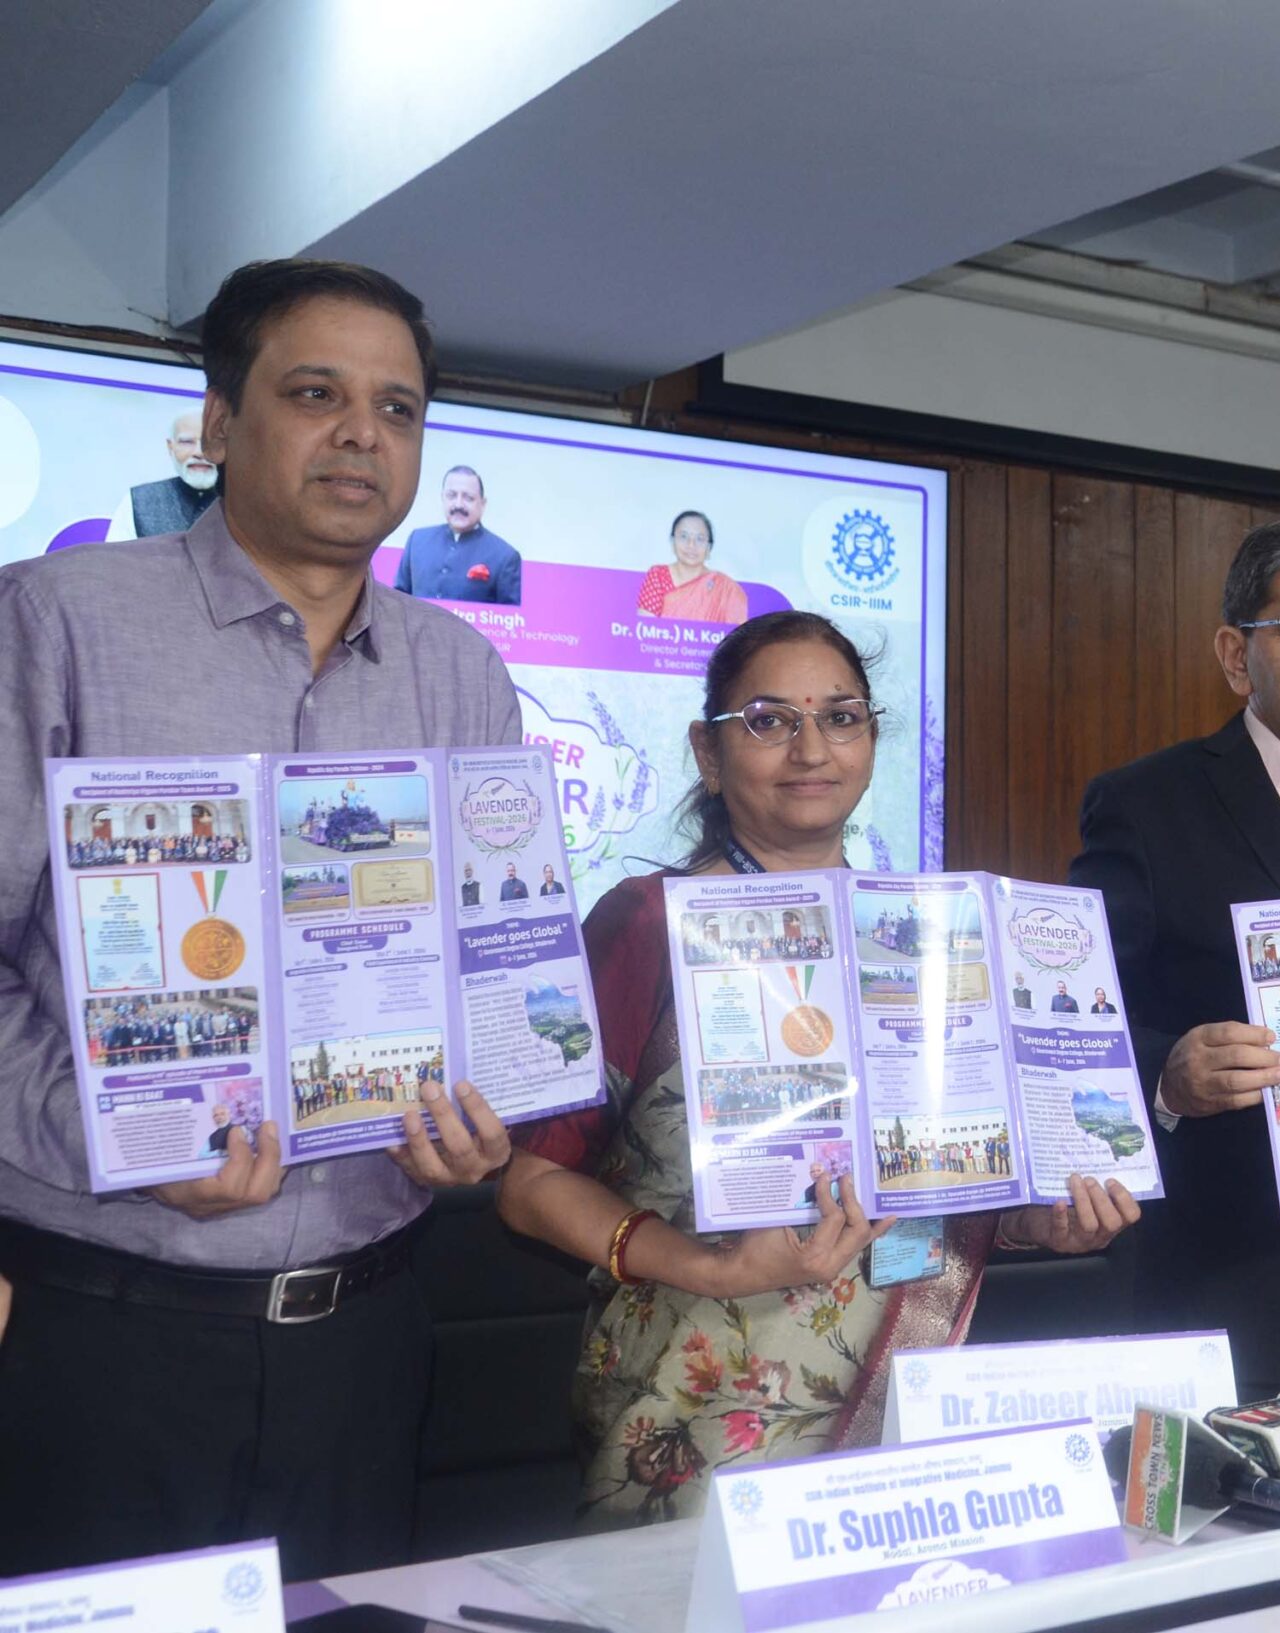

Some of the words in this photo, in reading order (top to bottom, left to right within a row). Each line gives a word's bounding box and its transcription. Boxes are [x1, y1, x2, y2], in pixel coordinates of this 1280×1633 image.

[829, 593, 893, 611] CSIR-IIIM
[479, 610, 525, 630] Singh
[510, 631, 517, 639] &
[520, 630, 580, 646] Technology
[611, 622, 633, 637] Dr.
[635, 622, 680, 643] (Mrs.)
[683, 627, 700, 641] N.
[495, 643, 511, 652] SIR
[640, 642, 677, 656] Director
[654, 659, 662, 668] &
[91, 770, 140, 782] National
[146, 769, 218, 783] Recognition
[562, 779, 590, 815] R
[469, 798, 529, 815] LAVENDER
[474, 815, 527, 827] FESTIVAL-2026
[563, 824, 576, 848] 6
[701, 885, 741, 896] National
[744, 882, 803, 894] Recognition
[310, 926, 358, 939] PROGRAMME
[361, 922, 405, 934] SCHEDULE
[508, 931, 532, 944] goes
[1018, 922, 1079, 941] LAVENDER
[1023, 937, 1078, 950] FESTIVAL-2026
[465, 972, 508, 987] Bhaderwah
[1059, 1038, 1081, 1050] goes
[1021, 1067, 1057, 1079] Bhaderwah
[940, 1393, 979, 1428] Dr.
[985, 1389, 1089, 1424] Zabeer
[1095, 1379, 1198, 1414] Ahmed
[1151, 1411, 1163, 1448] NEWS
[1148, 1451, 1161, 1489] TOWN
[854, 1481, 887, 1497] Institute
[889, 1478, 899, 1490] of
[899, 1471, 943, 1491] Integrative
[944, 1467, 982, 1483] Medicine,
[984, 1462, 1012, 1476] Jammu
[787, 1516, 836, 1560] Dr.
[838, 1492, 960, 1554] Suphla
[965, 1481, 1065, 1530] Gupta
[1143, 1493, 1157, 1531] CROSS
[883, 1547, 916, 1561] Nodal,
[917, 1541, 949, 1556] Aroma
[949, 1535, 986, 1549] Mission
[898, 1578, 990, 1607] LAVENDER
